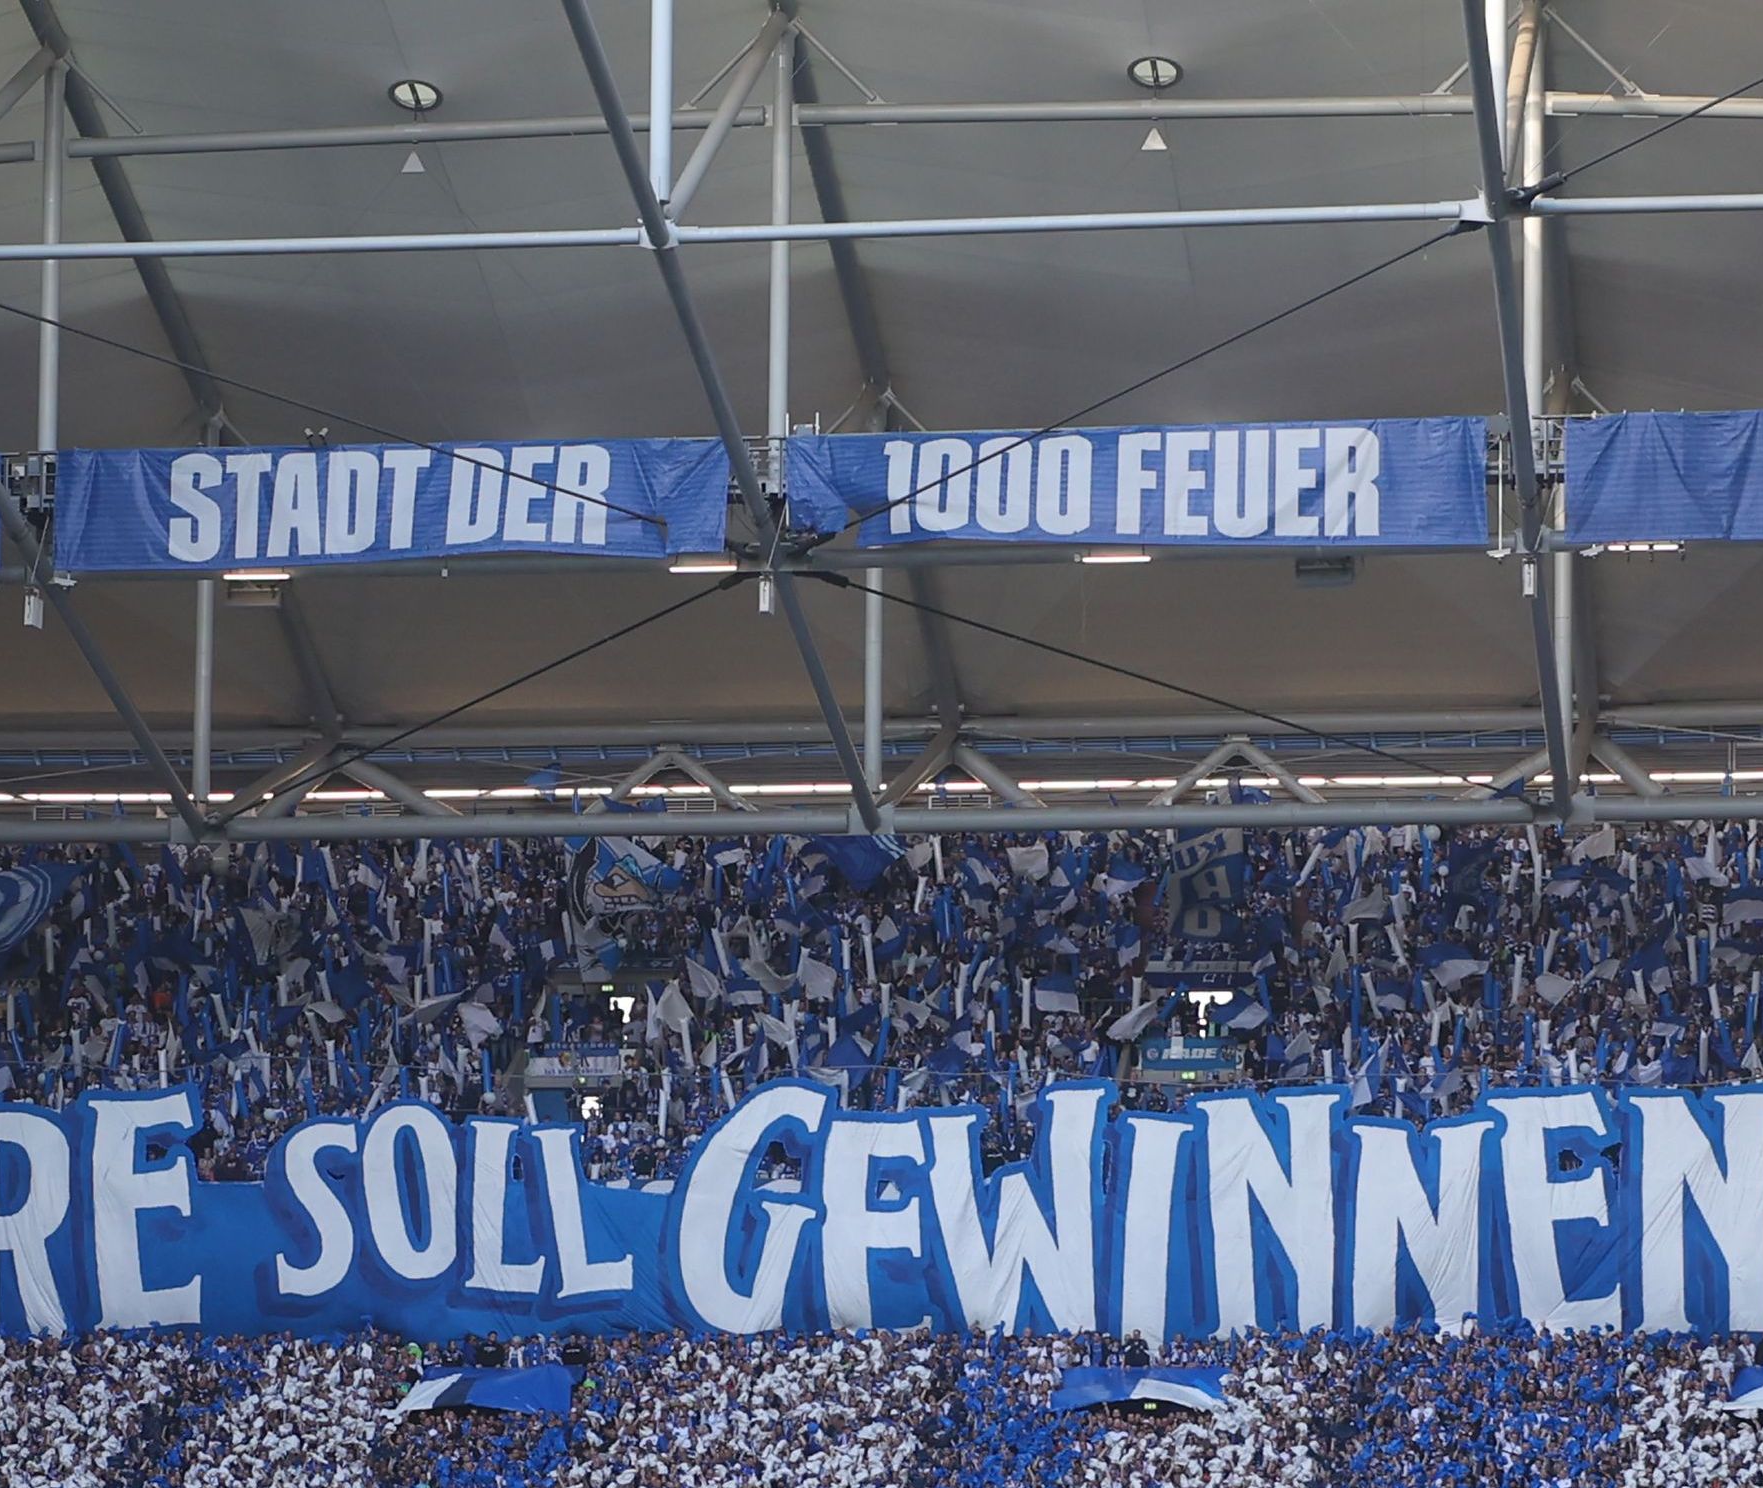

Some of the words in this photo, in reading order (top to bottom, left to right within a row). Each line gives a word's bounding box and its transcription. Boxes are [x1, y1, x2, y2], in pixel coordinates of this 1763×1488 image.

[168, 447, 435, 563] STADT
[447, 444, 611, 547] DER
[883, 437, 1092, 538] 1000
[1115, 427, 1382, 538] FEUER
[276, 1105, 633, 1301] SOLL
